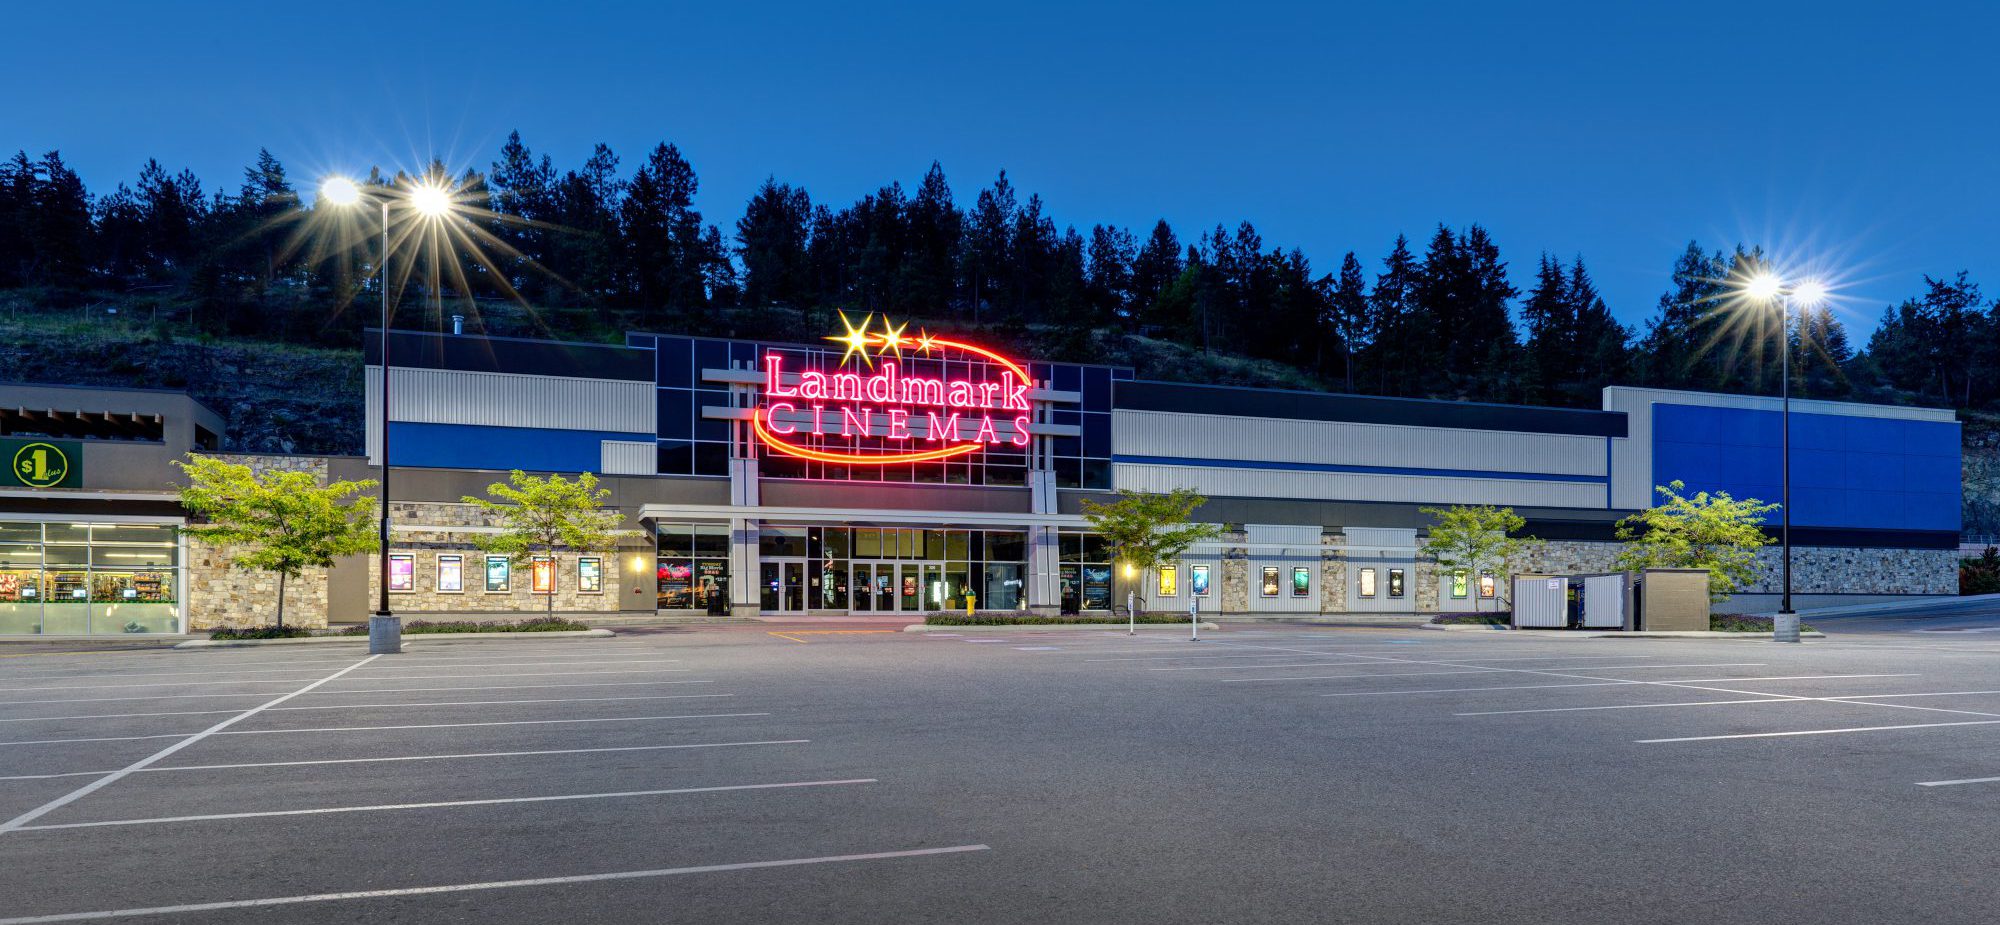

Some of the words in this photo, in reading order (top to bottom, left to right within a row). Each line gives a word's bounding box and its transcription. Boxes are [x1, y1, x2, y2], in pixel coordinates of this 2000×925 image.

[765, 355, 1030, 411] Landmark
[766, 402, 1031, 446] CINEMAS
[21, 449, 49, 480] $1
